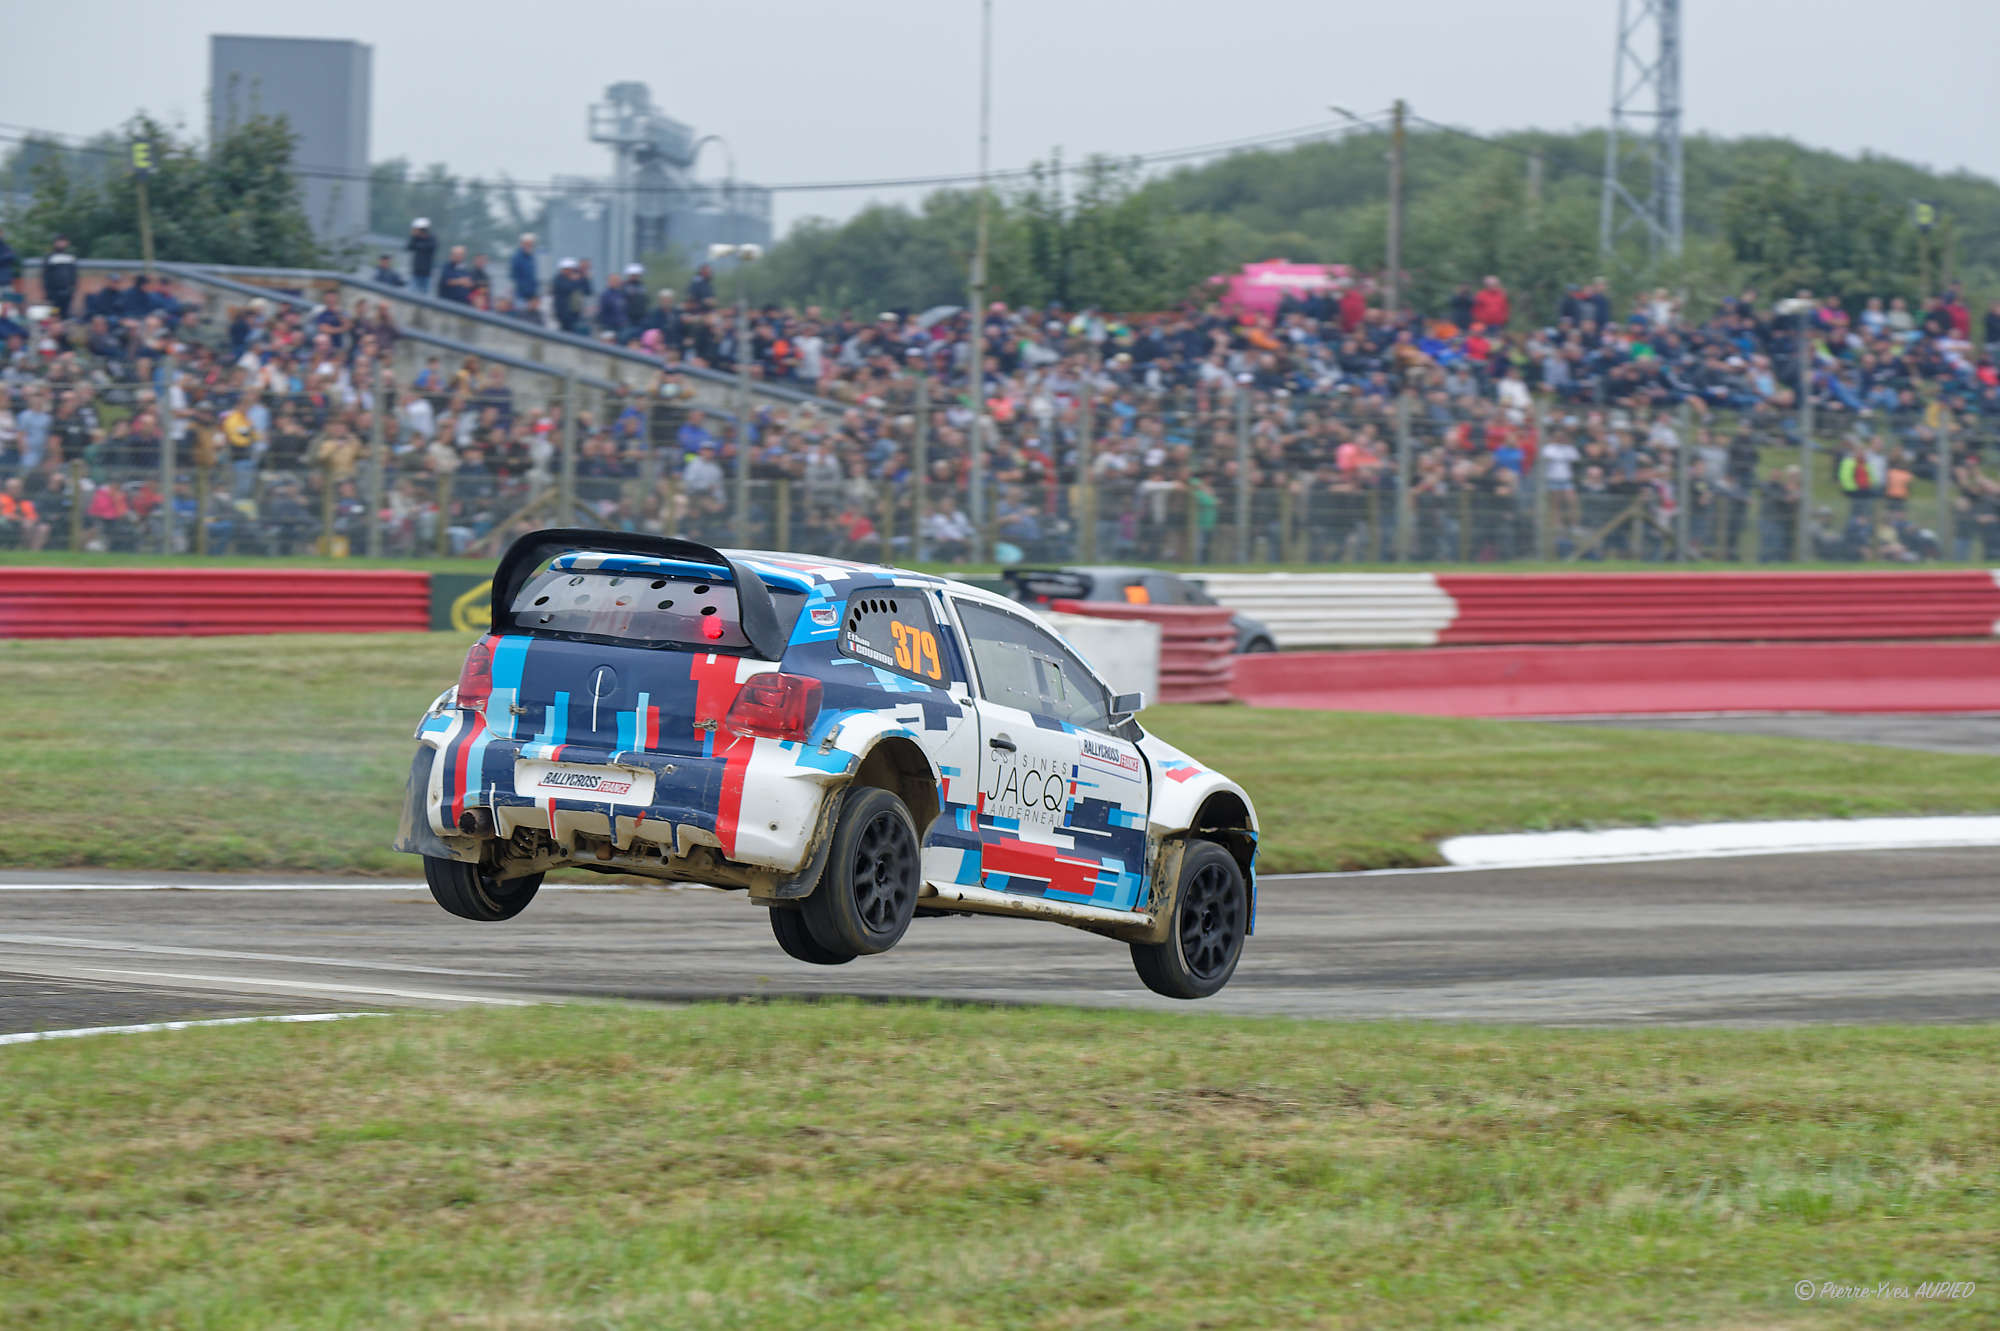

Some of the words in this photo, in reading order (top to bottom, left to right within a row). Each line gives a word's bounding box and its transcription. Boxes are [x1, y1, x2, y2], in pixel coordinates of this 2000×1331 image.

[890, 620, 941, 681] 379
[1083, 739, 1119, 762] RALLYCROSS
[543, 772, 602, 788] RALLYCROSS
[601, 781, 630, 794] FRANCE
[987, 764, 1064, 812] JACQ
